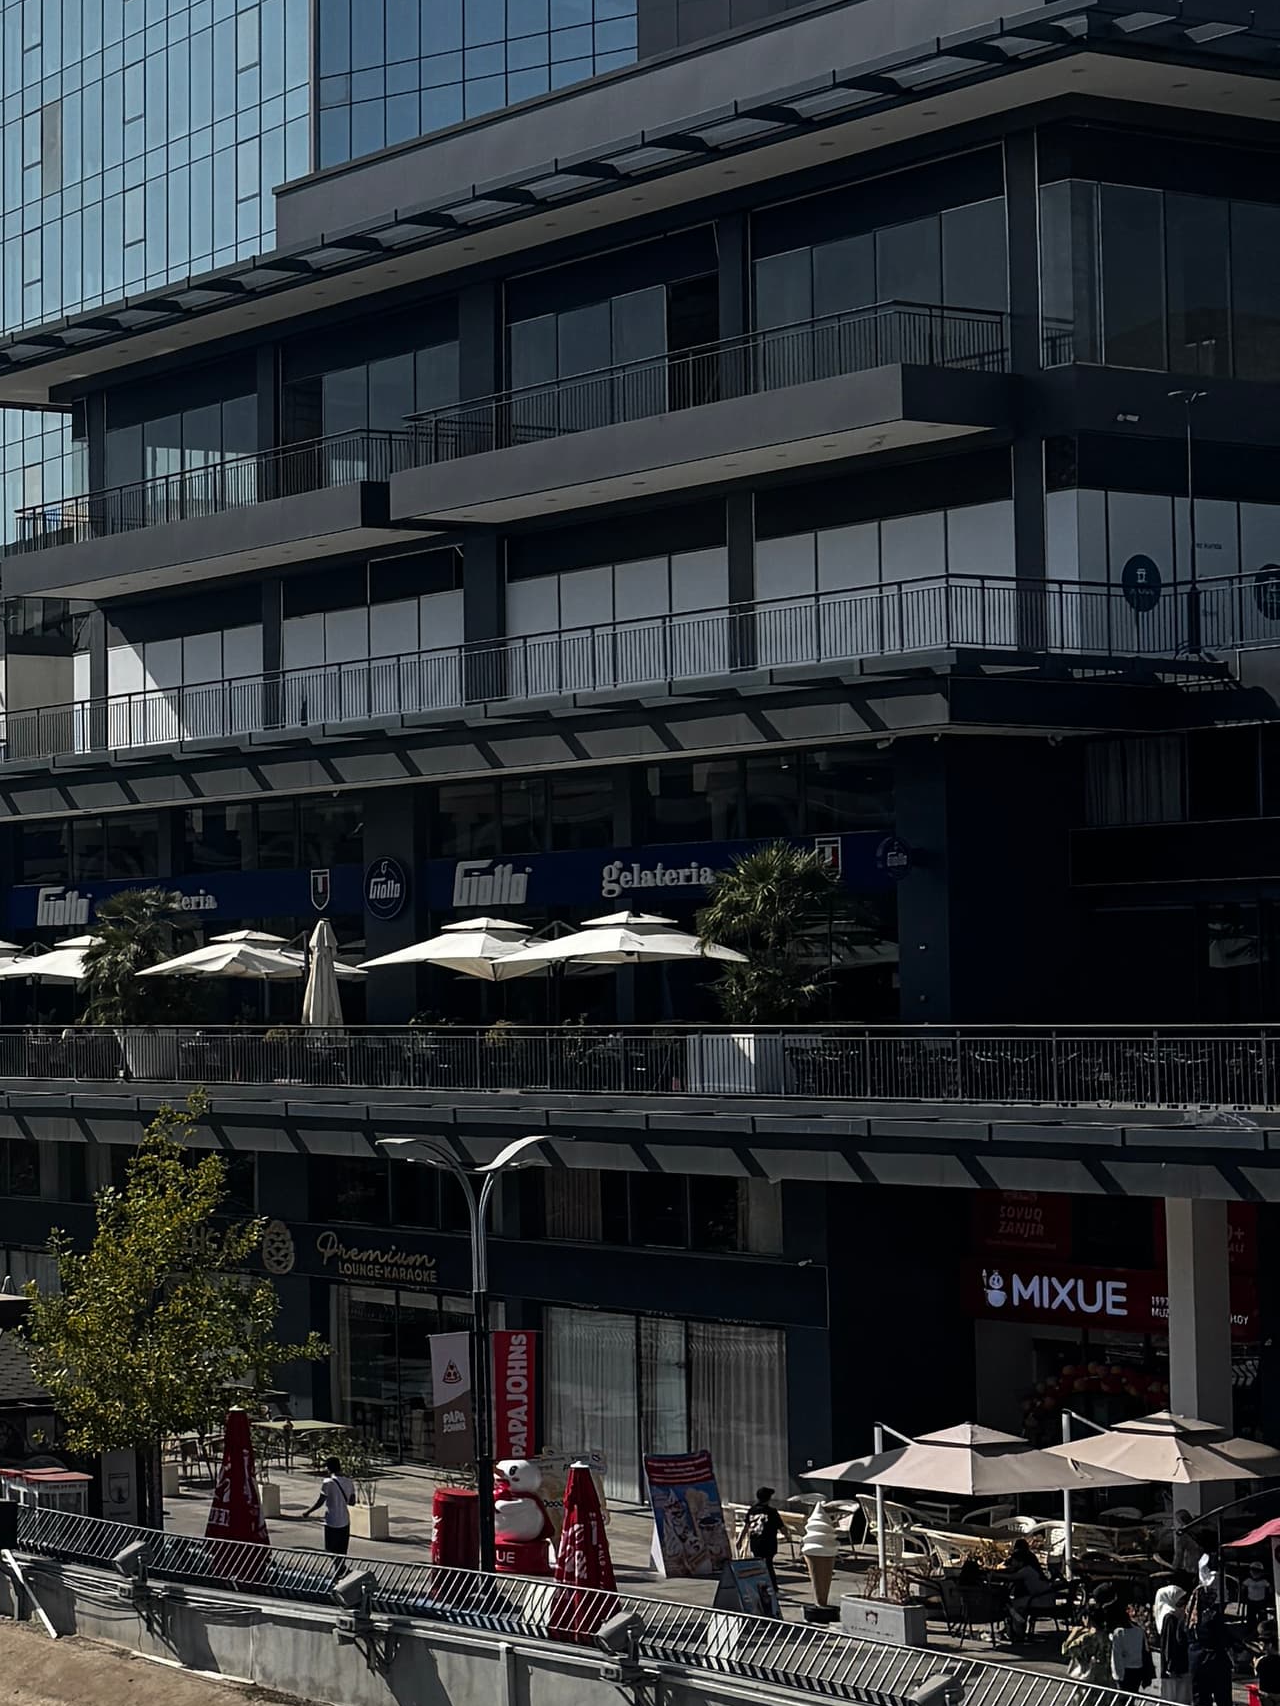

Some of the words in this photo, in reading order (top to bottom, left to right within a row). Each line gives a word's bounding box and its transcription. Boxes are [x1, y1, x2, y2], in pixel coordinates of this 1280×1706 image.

[601, 860, 718, 898] gelateria
[316, 1230, 436, 1266] Premium
[1010, 1272, 1129, 1317] MIXUE
